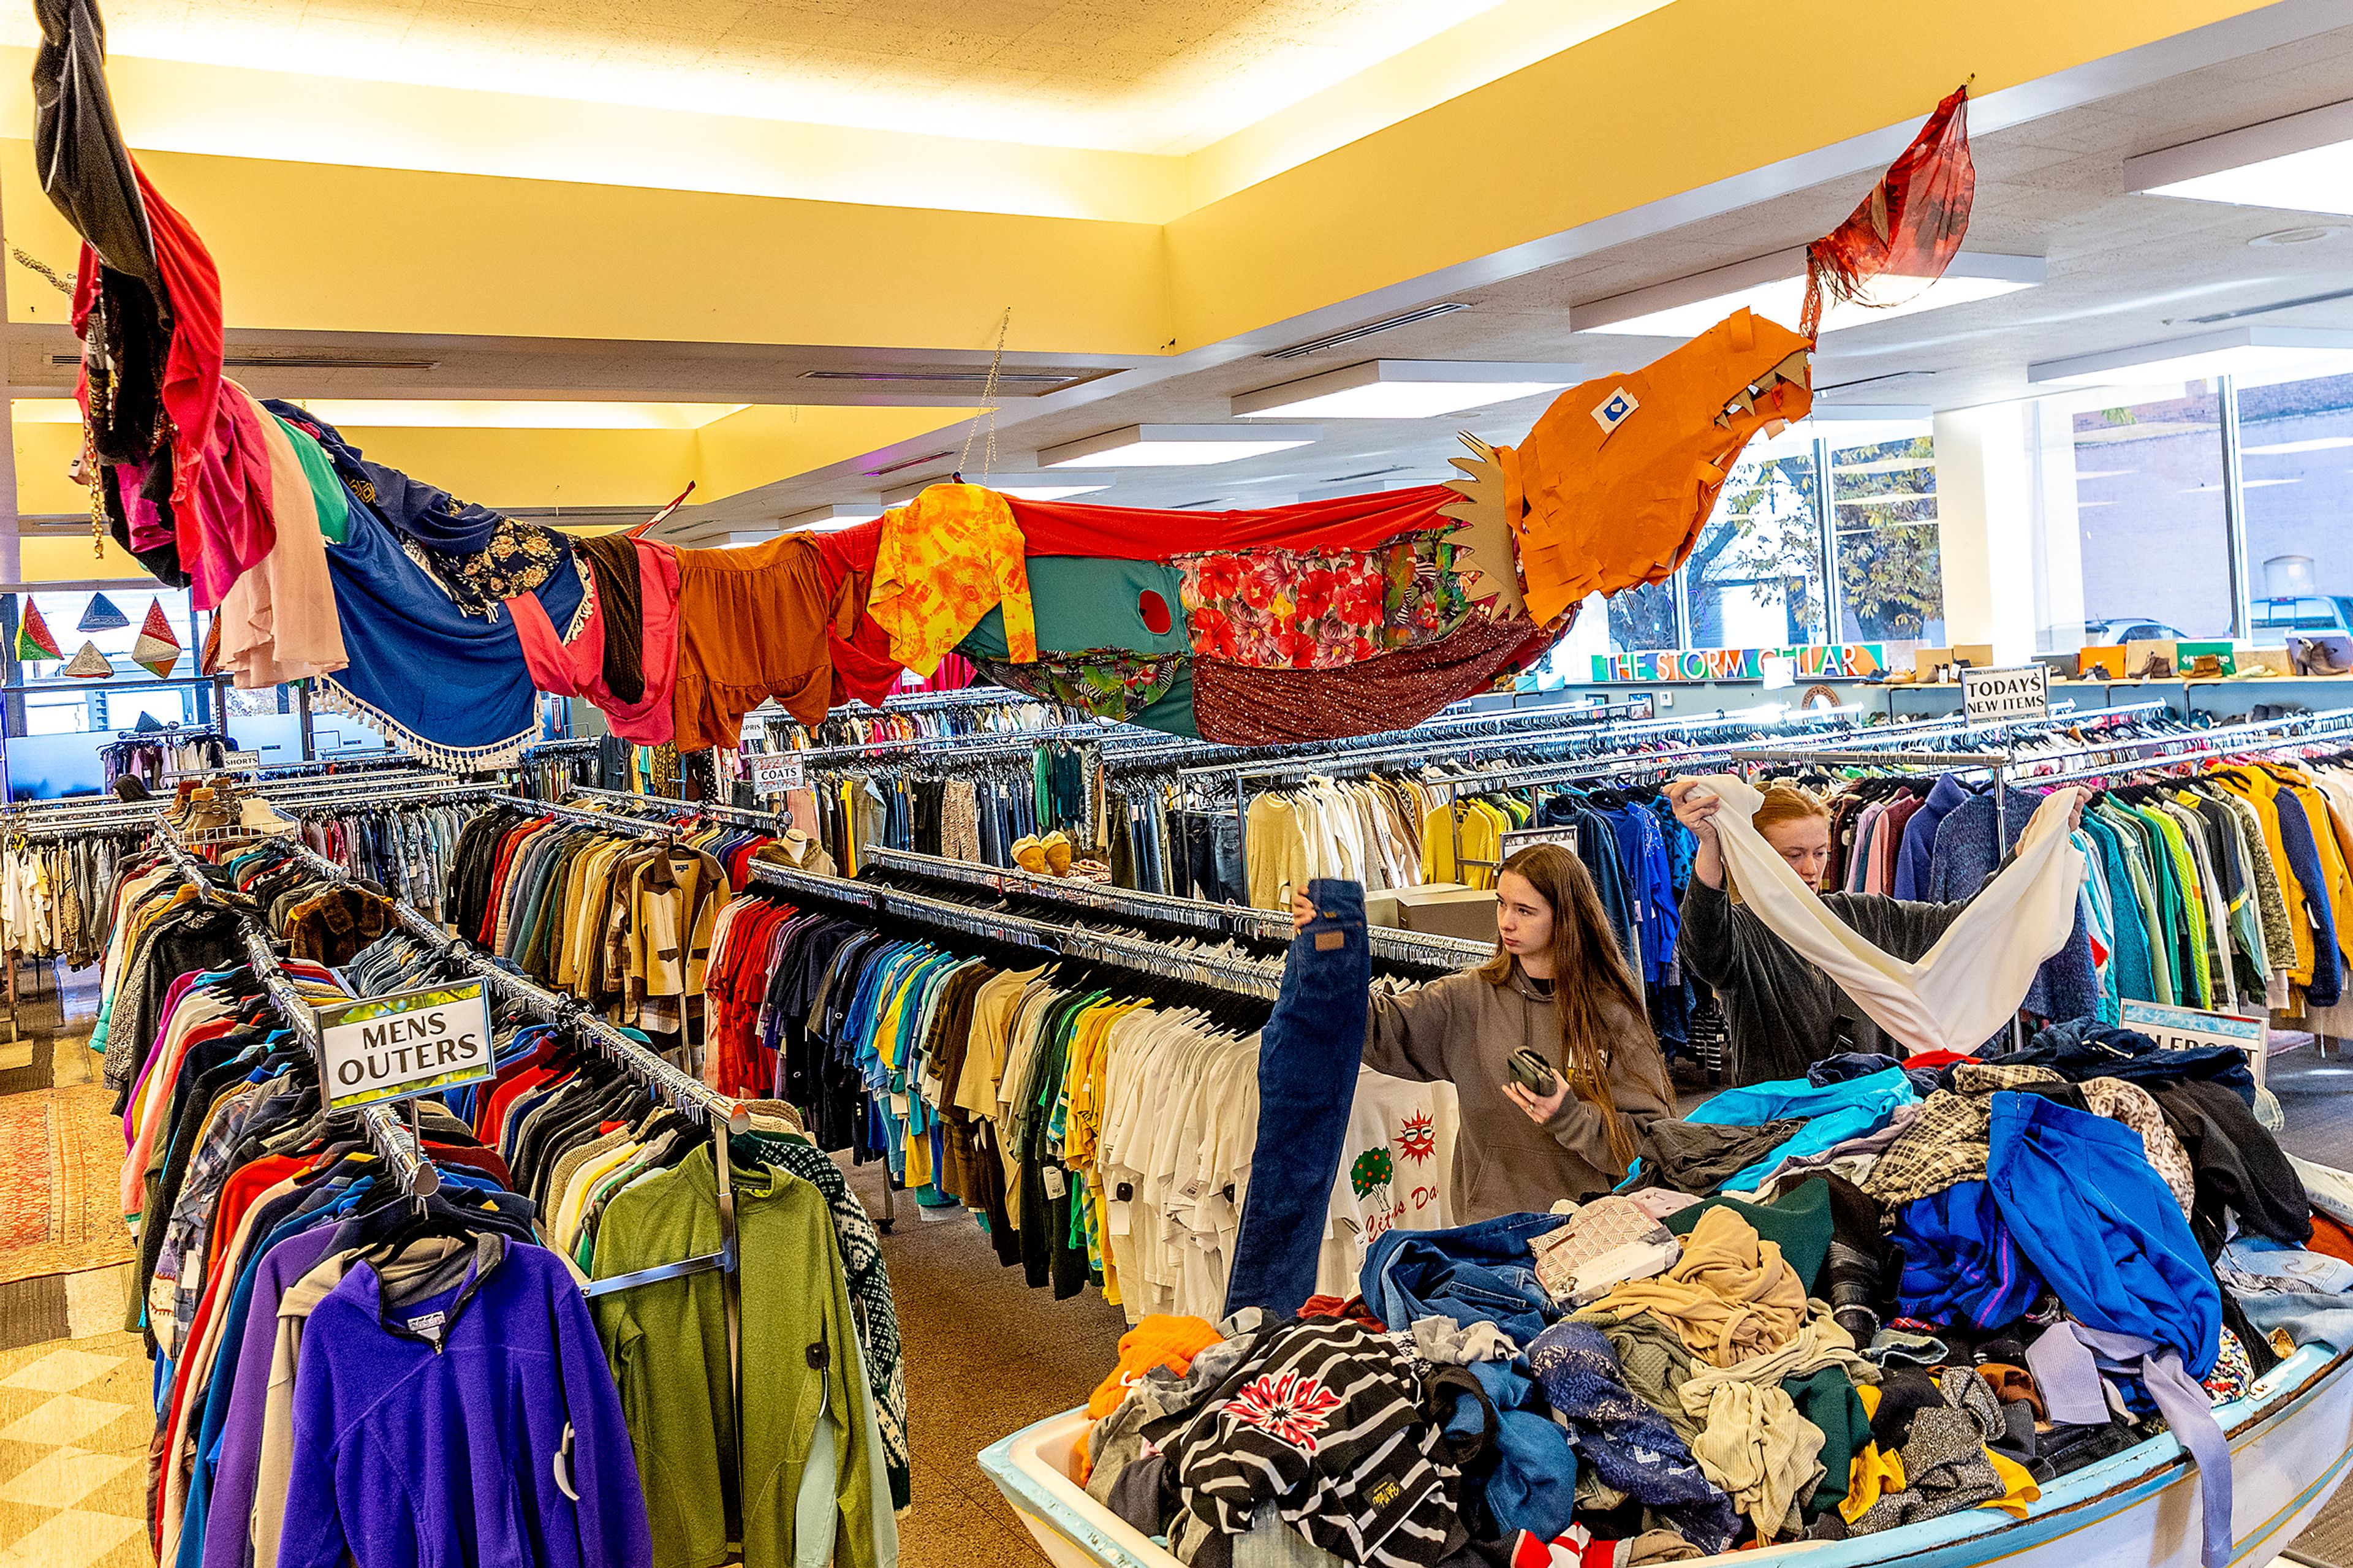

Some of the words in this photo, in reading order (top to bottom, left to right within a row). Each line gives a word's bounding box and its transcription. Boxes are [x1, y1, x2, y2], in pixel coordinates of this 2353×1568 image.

[1602, 653, 1648, 682] THE
[1656, 648, 1749, 681] STORM
[1966, 672, 2041, 698] TODAY'S
[1968, 700, 1998, 714] NEW
[2003, 695, 2044, 710] ITEMS
[225, 757, 258, 766] SHORTS
[761, 767, 797, 781] COATS
[565, 1002, 576, 1011] XL
[362, 1012, 447, 1050] MENS
[338, 1033, 479, 1086] OUTERS
[1411, 1183, 1439, 1210] Da
